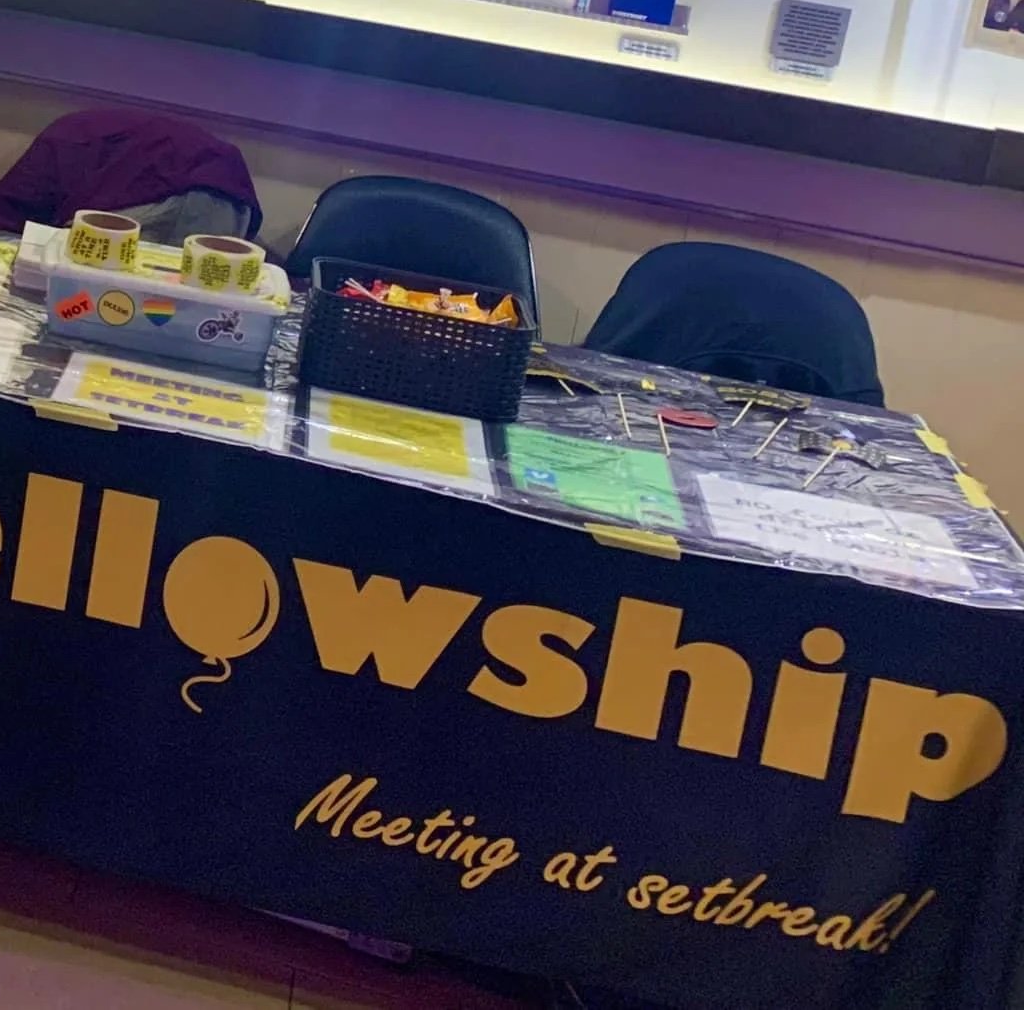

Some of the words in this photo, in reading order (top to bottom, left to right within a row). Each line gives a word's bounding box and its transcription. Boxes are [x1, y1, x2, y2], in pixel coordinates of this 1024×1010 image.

[60, 299, 90, 319] HOT
[109, 367, 245, 403] MEETING
[292, 773, 520, 891] Meeting
[543, 844, 618, 894] at
[627, 872, 938, 956] setbreak!
